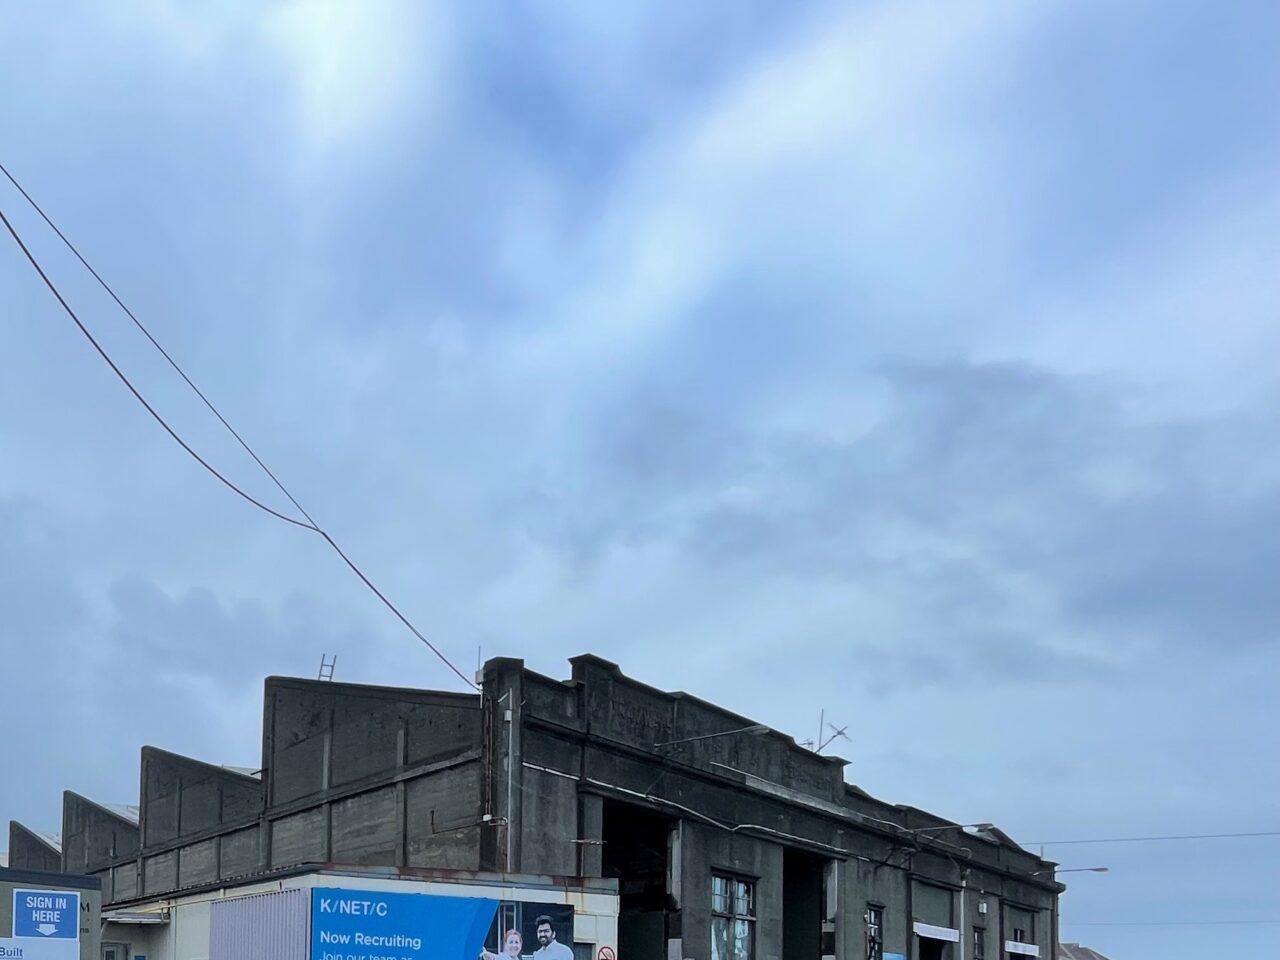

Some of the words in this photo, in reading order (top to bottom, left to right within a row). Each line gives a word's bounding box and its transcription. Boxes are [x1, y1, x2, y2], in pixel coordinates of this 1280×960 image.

[26, 896, 52, 909] SIGN
[55, 898, 67, 910] IN
[32, 910, 61, 922] HERE
[320, 930, 351, 945] Now
[355, 932, 422, 950] Recruiting
